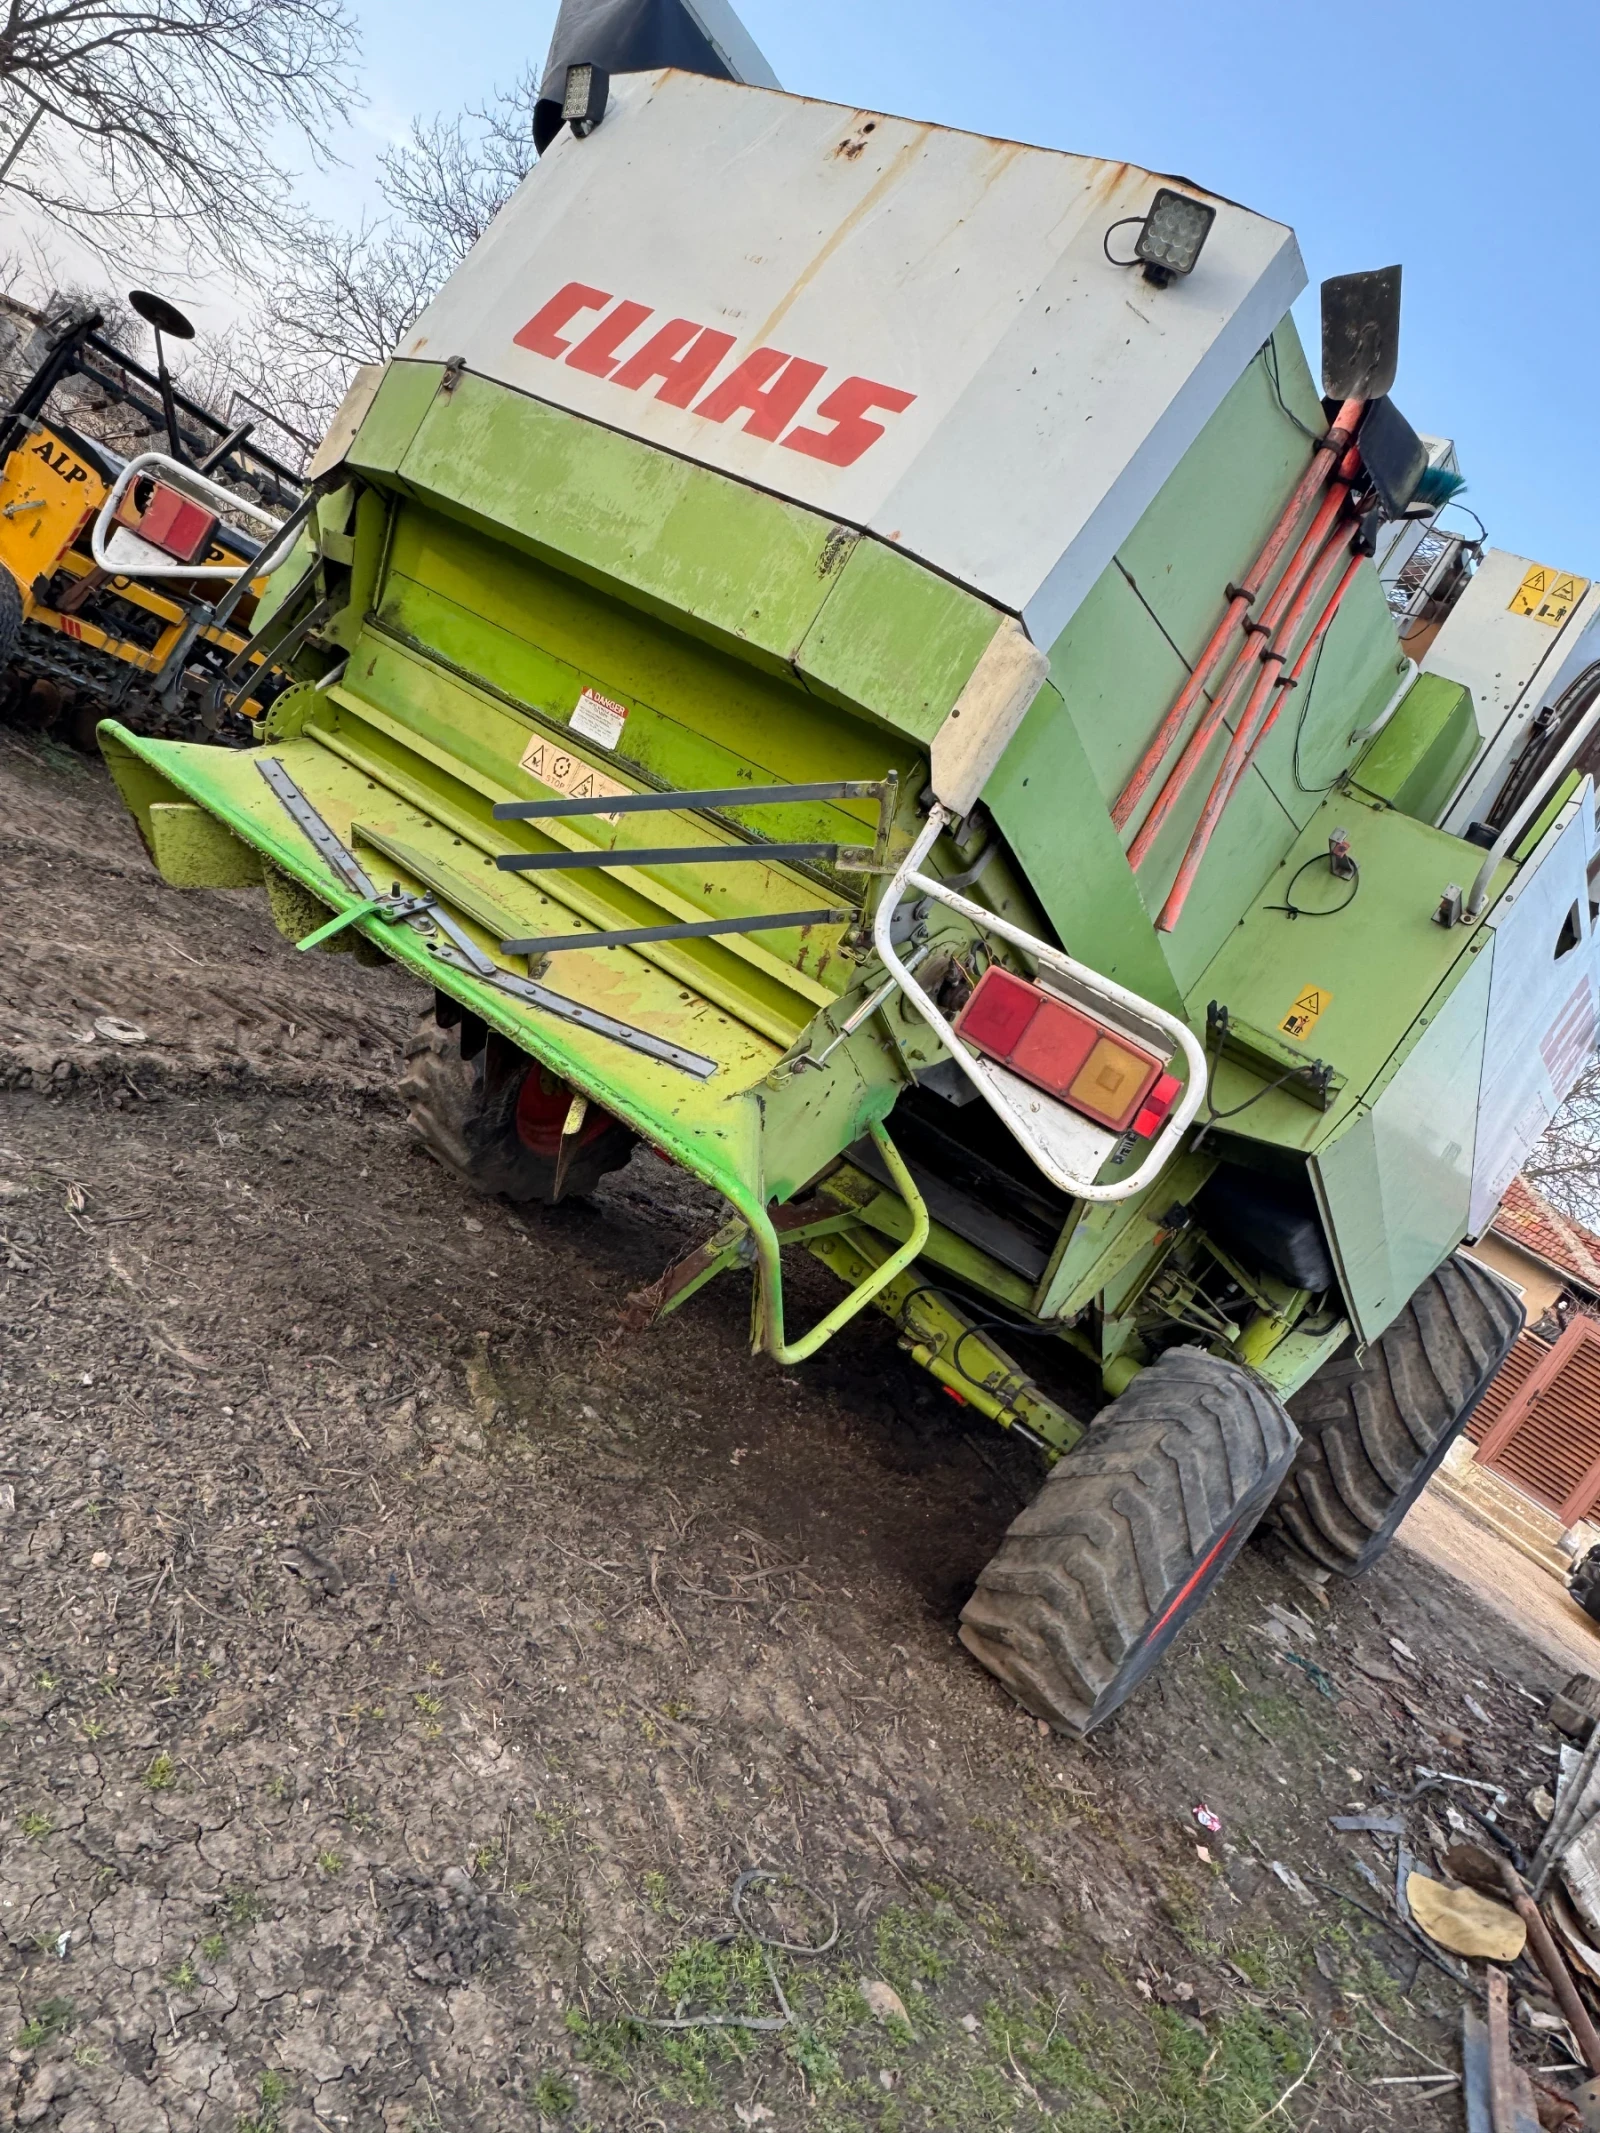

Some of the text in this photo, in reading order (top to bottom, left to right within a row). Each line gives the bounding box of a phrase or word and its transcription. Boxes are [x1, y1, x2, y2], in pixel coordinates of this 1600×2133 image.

[513, 281, 918, 467] CLAAS
[31, 441, 88, 483] ALP
[594, 692, 626, 716] DANGER
[545, 775, 565, 789] STOP
